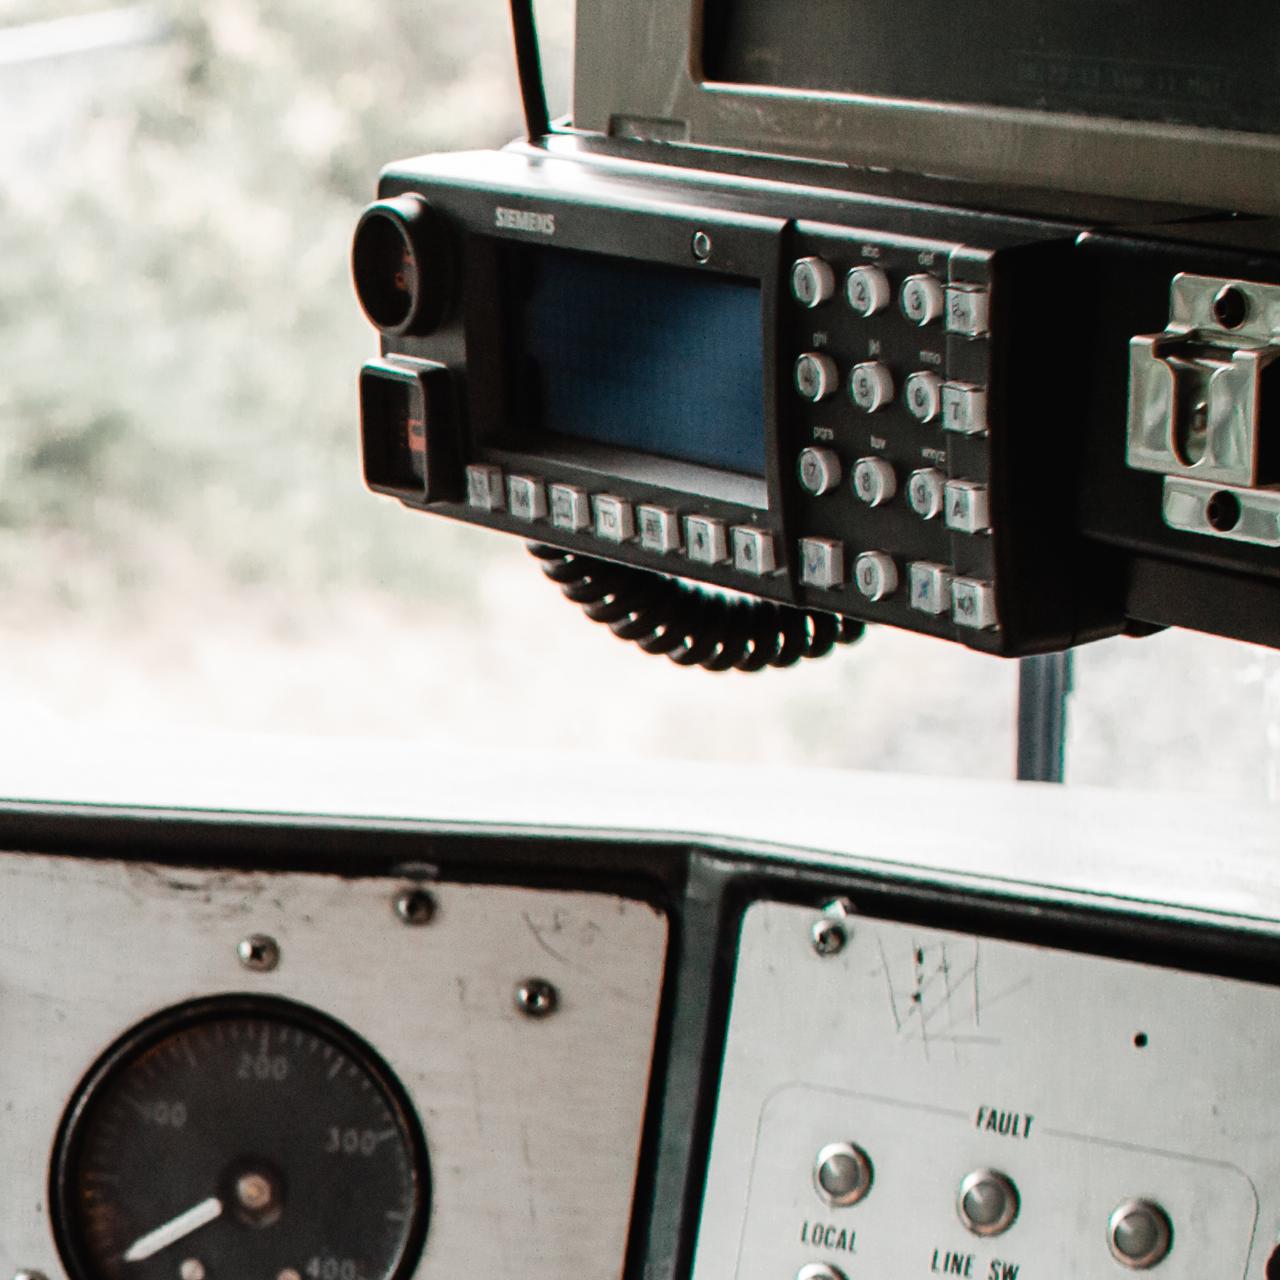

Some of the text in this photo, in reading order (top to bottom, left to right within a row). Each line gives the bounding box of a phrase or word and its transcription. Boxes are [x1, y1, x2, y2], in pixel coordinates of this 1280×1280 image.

[495, 206, 555, 236] SIEMENS
[976, 1106, 1034, 1138] FAULT
[800, 1221, 857, 1253] LOCAL
[931, 1250, 974, 1278] LINE
